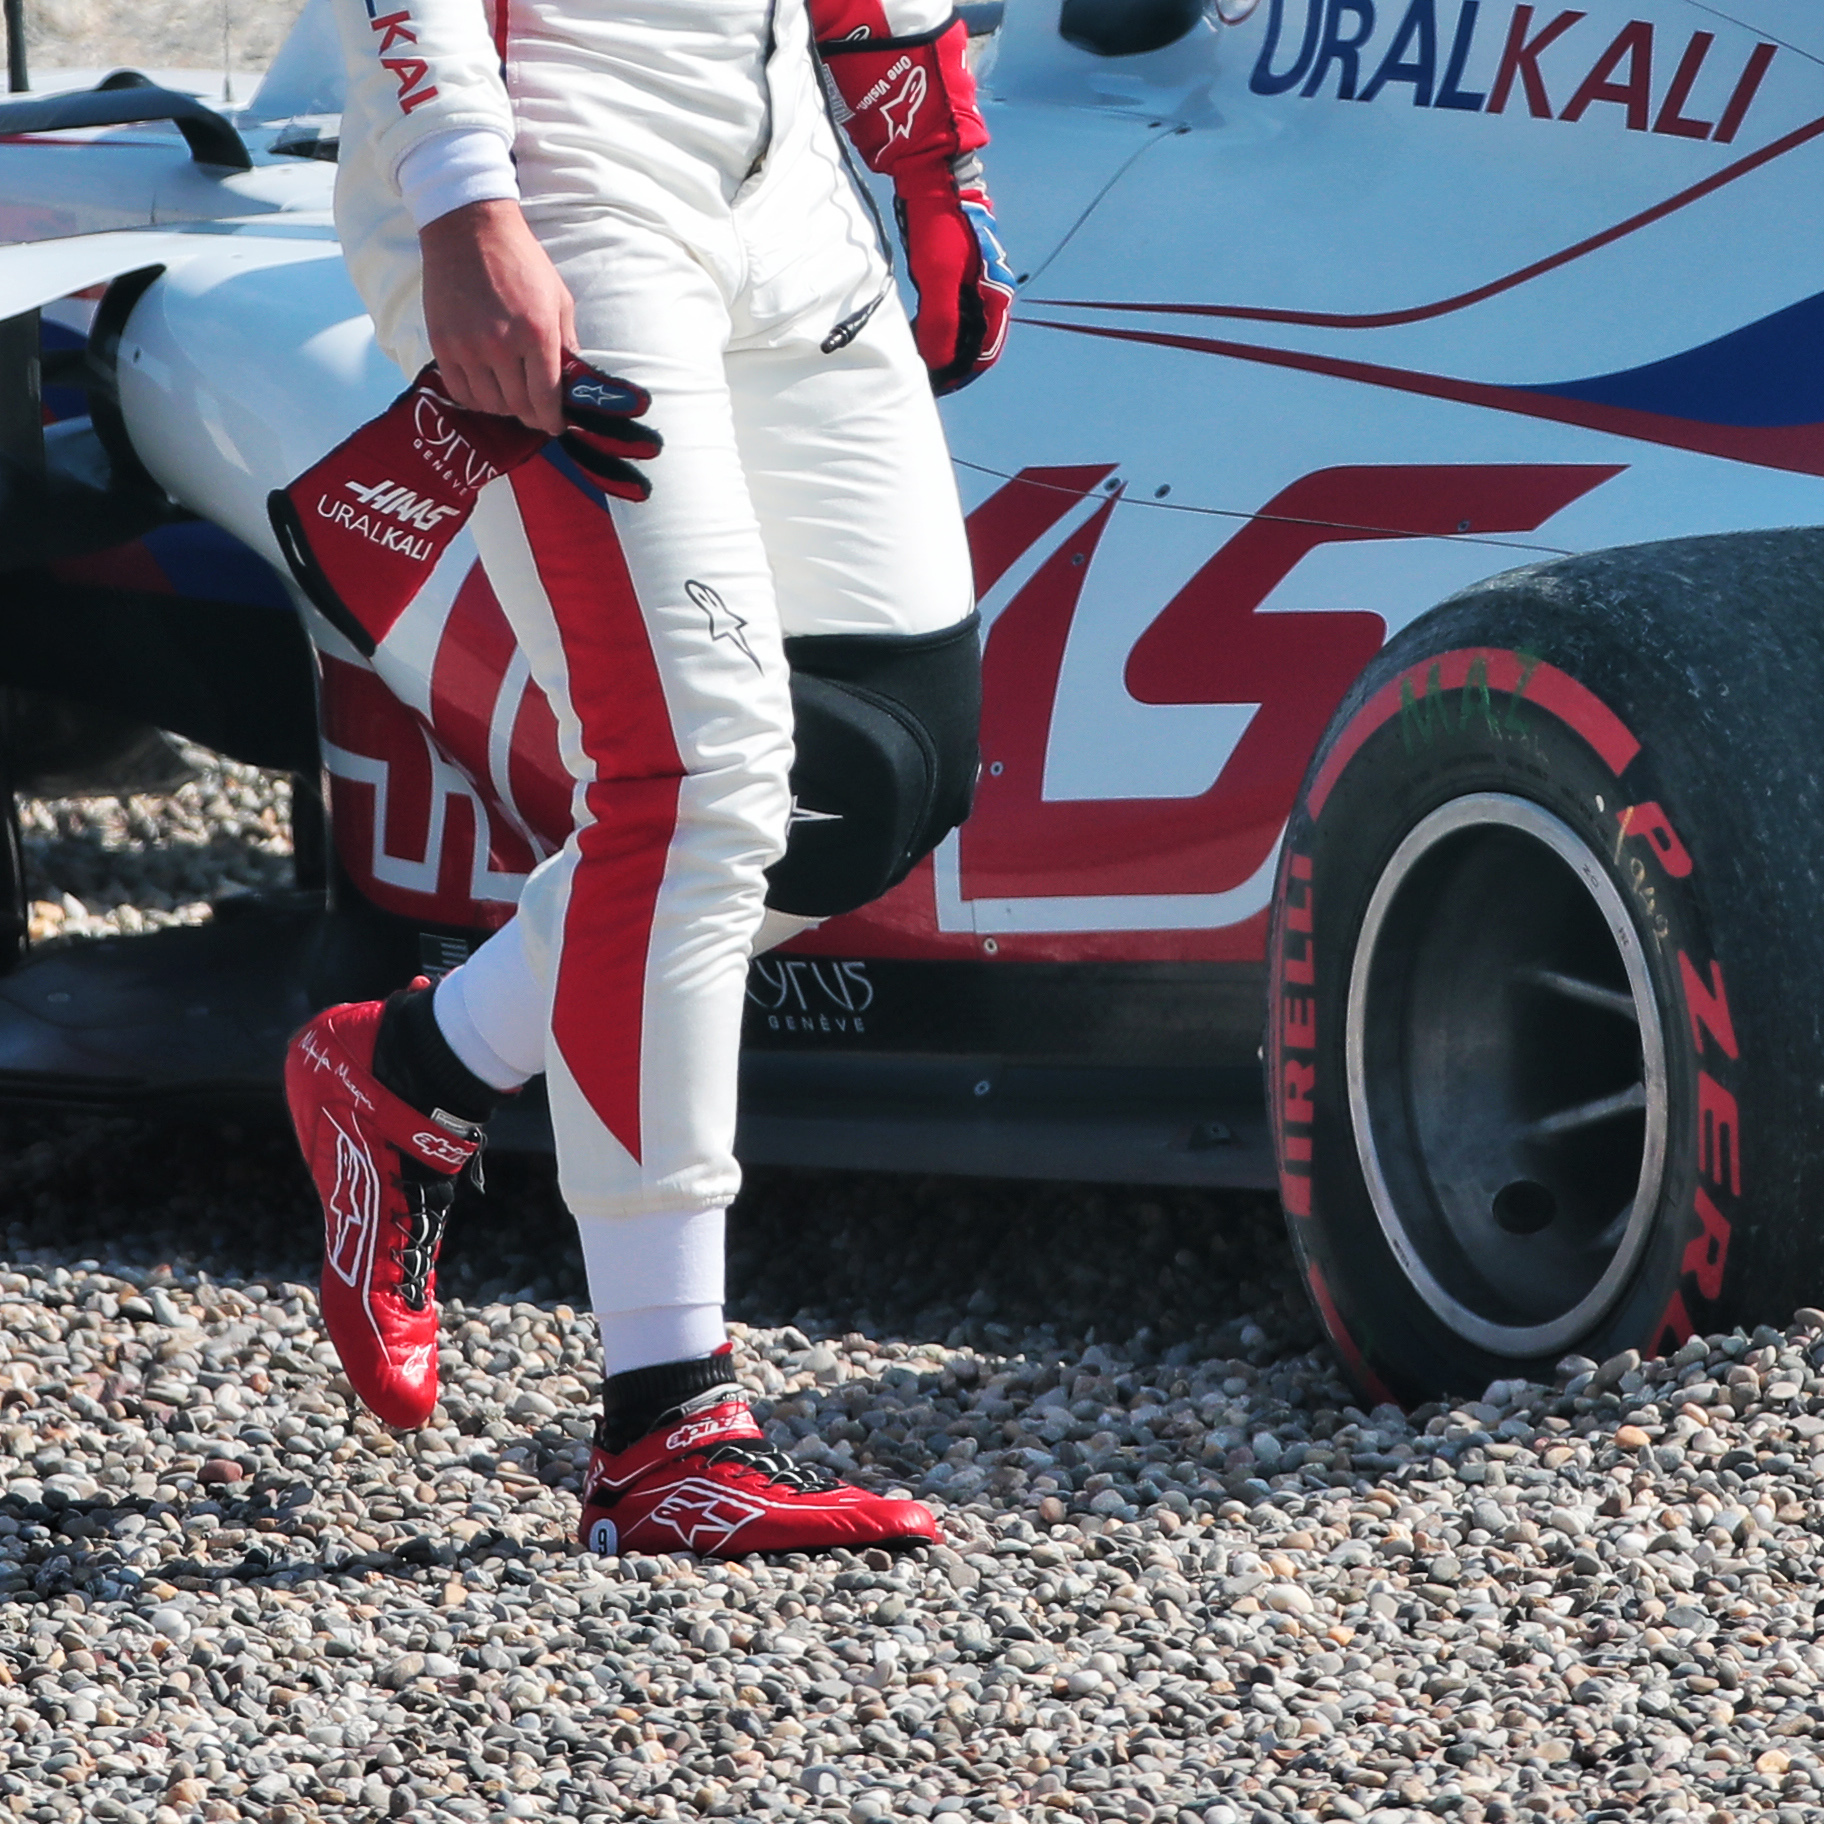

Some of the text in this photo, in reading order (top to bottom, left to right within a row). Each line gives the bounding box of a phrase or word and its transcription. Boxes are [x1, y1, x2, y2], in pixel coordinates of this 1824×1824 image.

[887, 55, 912, 81] One
[317, 494, 434, 561] URALKALI
[345, 479, 461, 531] HAAS
[1616, 800, 1694, 877] P
[1268, 843, 1318, 1217] PIRELLI
[597, 1528, 608, 1554] 9
